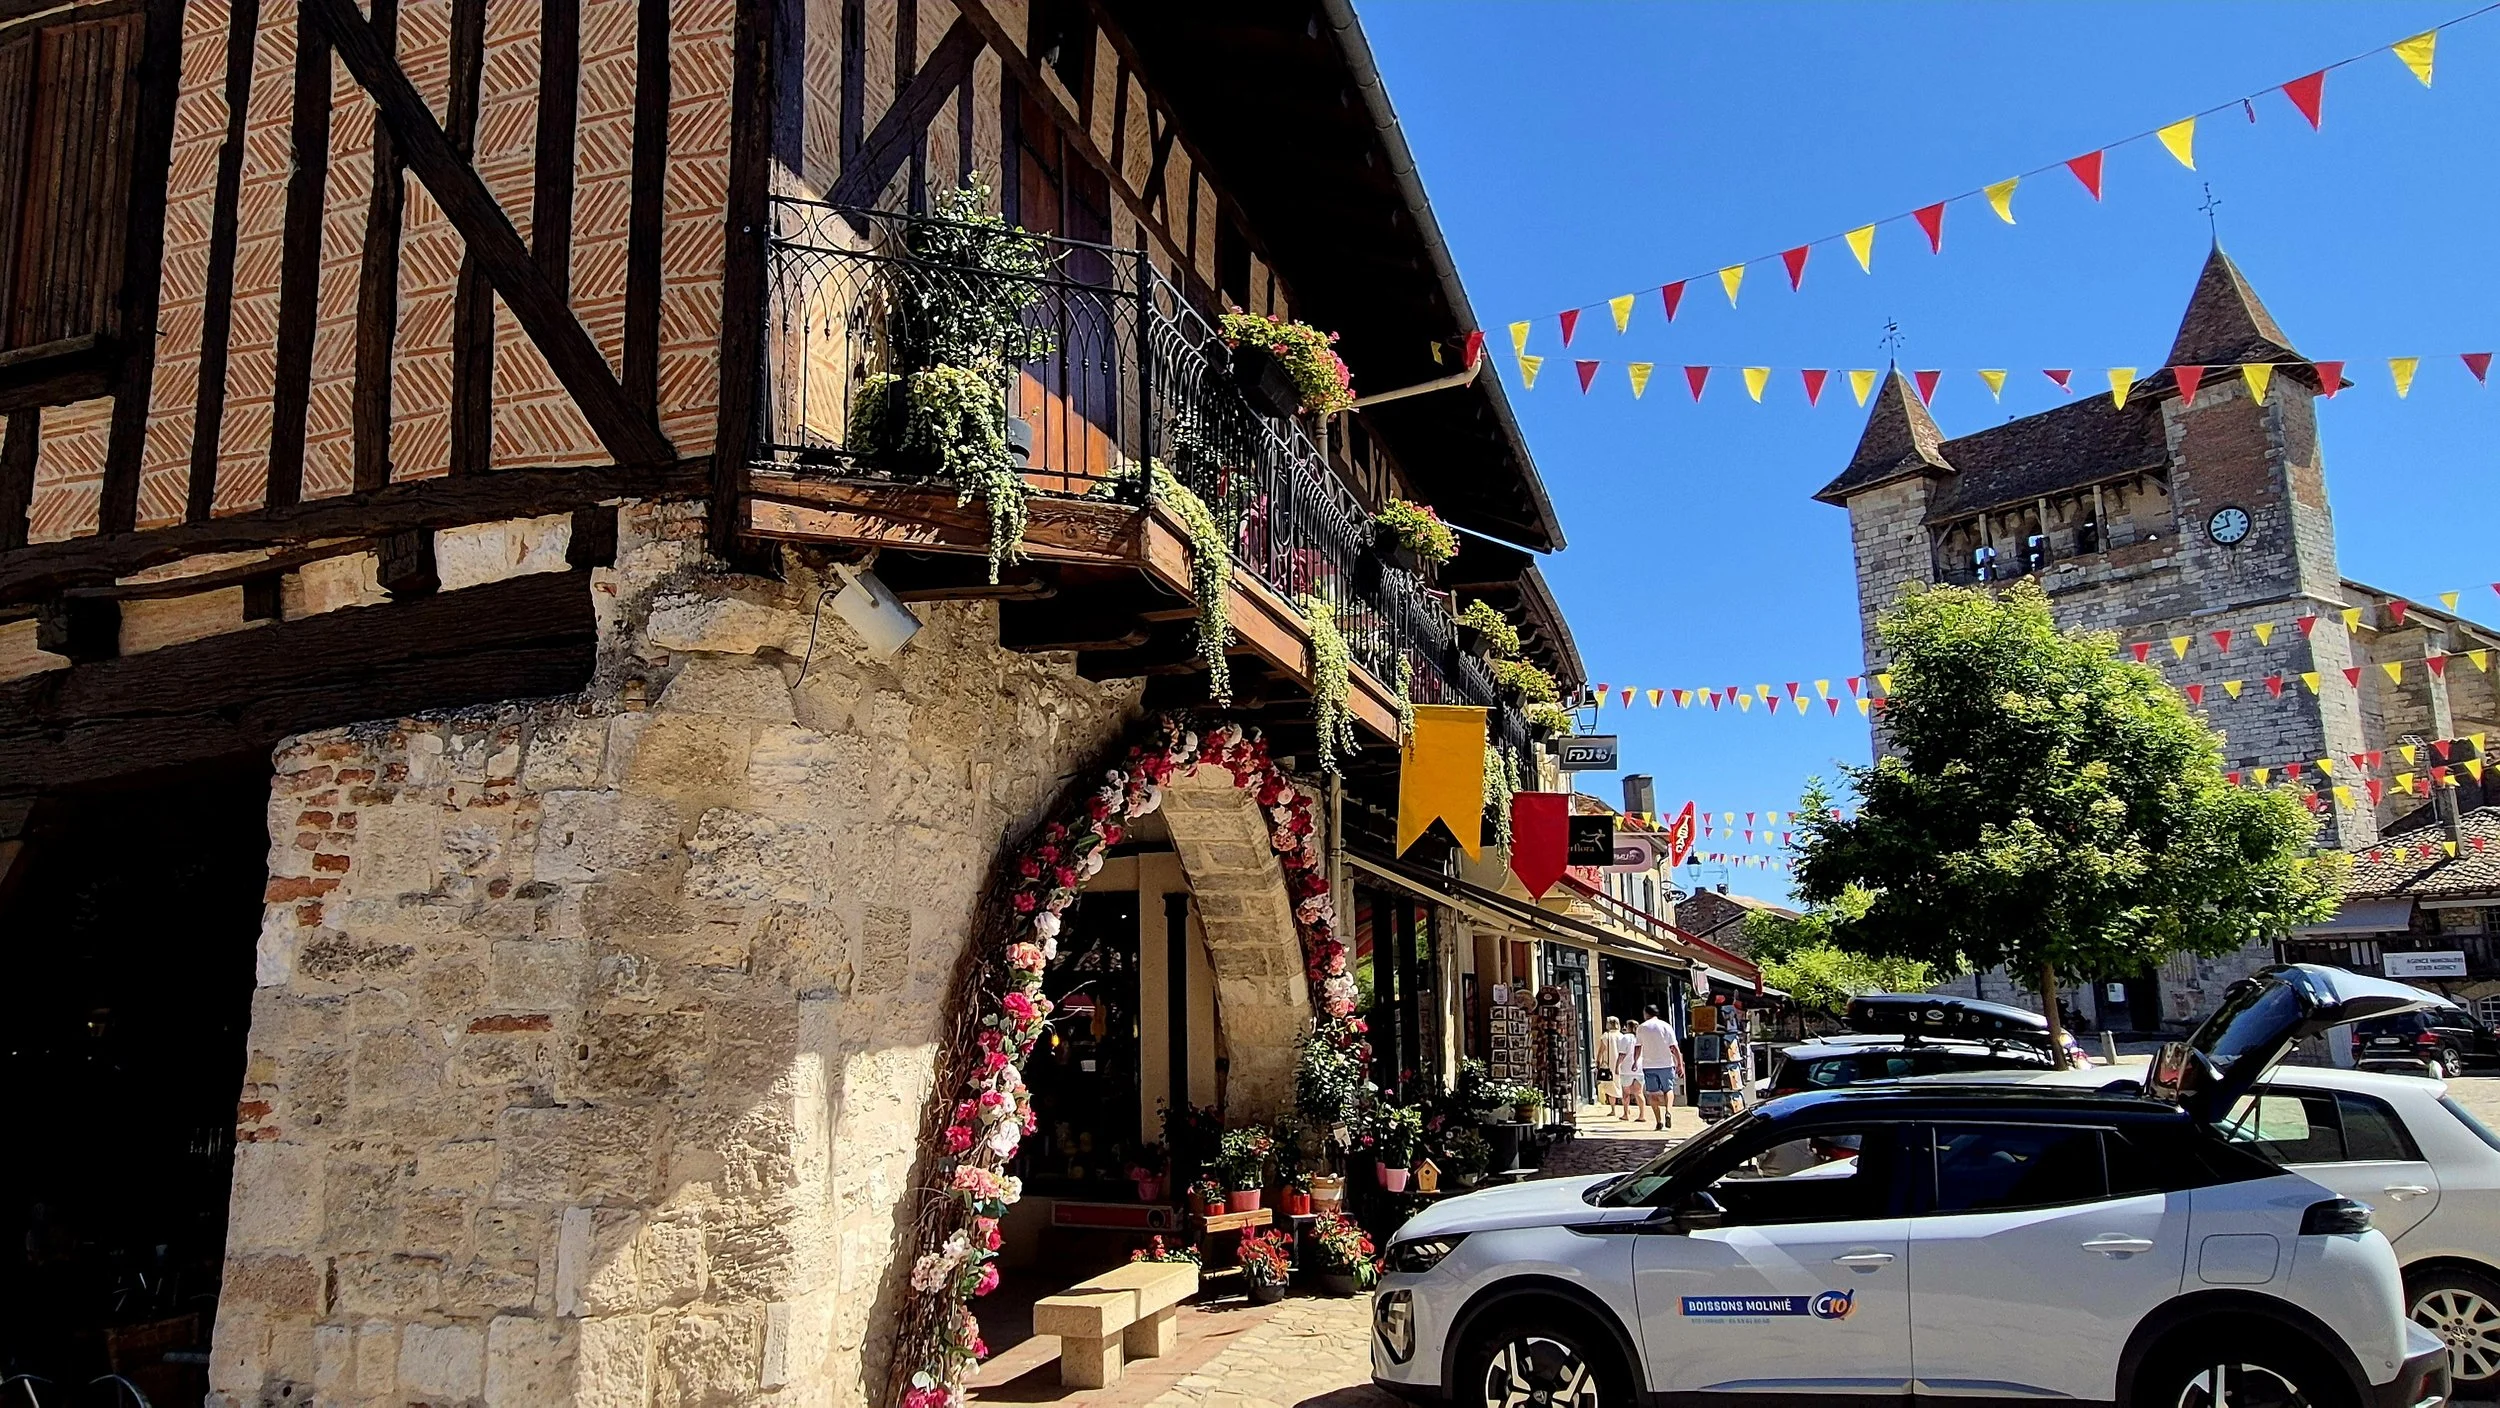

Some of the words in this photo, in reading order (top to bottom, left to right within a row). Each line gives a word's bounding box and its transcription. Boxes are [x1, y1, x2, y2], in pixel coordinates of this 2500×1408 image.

[1568, 749, 1595, 761] FDJ
[1675, 814, 1692, 854] TABAC
[1688, 1300, 1744, 1312] BOISSONS
[1746, 1298, 1792, 1312] MOLINIÉ
[1816, 1295, 1848, 1314] C10
